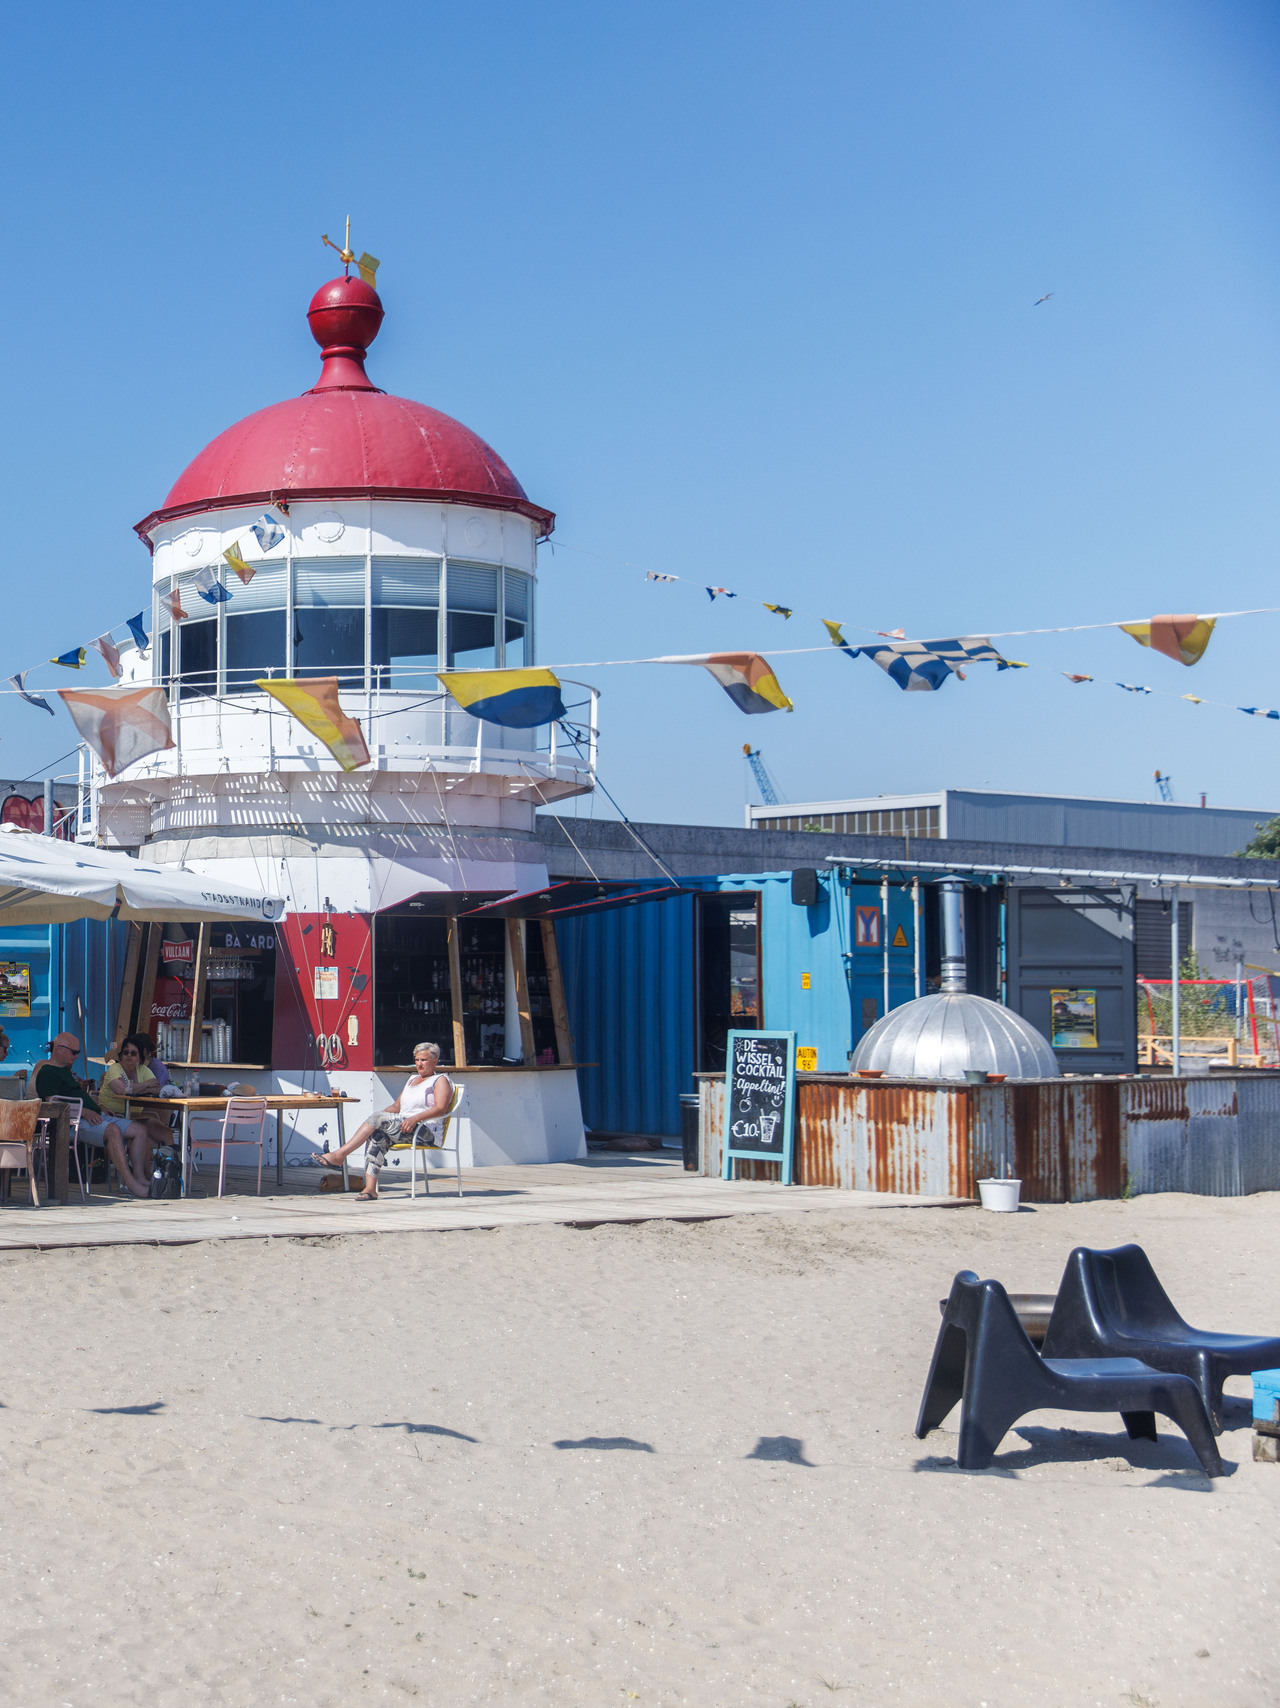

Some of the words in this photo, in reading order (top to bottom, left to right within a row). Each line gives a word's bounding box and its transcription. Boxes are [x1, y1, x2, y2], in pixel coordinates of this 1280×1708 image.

[201, 892, 261, 909] STAD&STRAND
[225, 934, 278, 949] BAARD
[164, 946, 190, 958] VULCAAN
[744, 1039, 758, 1051] DE
[736, 1051, 774, 1066] WISSEL
[737, 1063, 785, 1078] COCKTAIL
